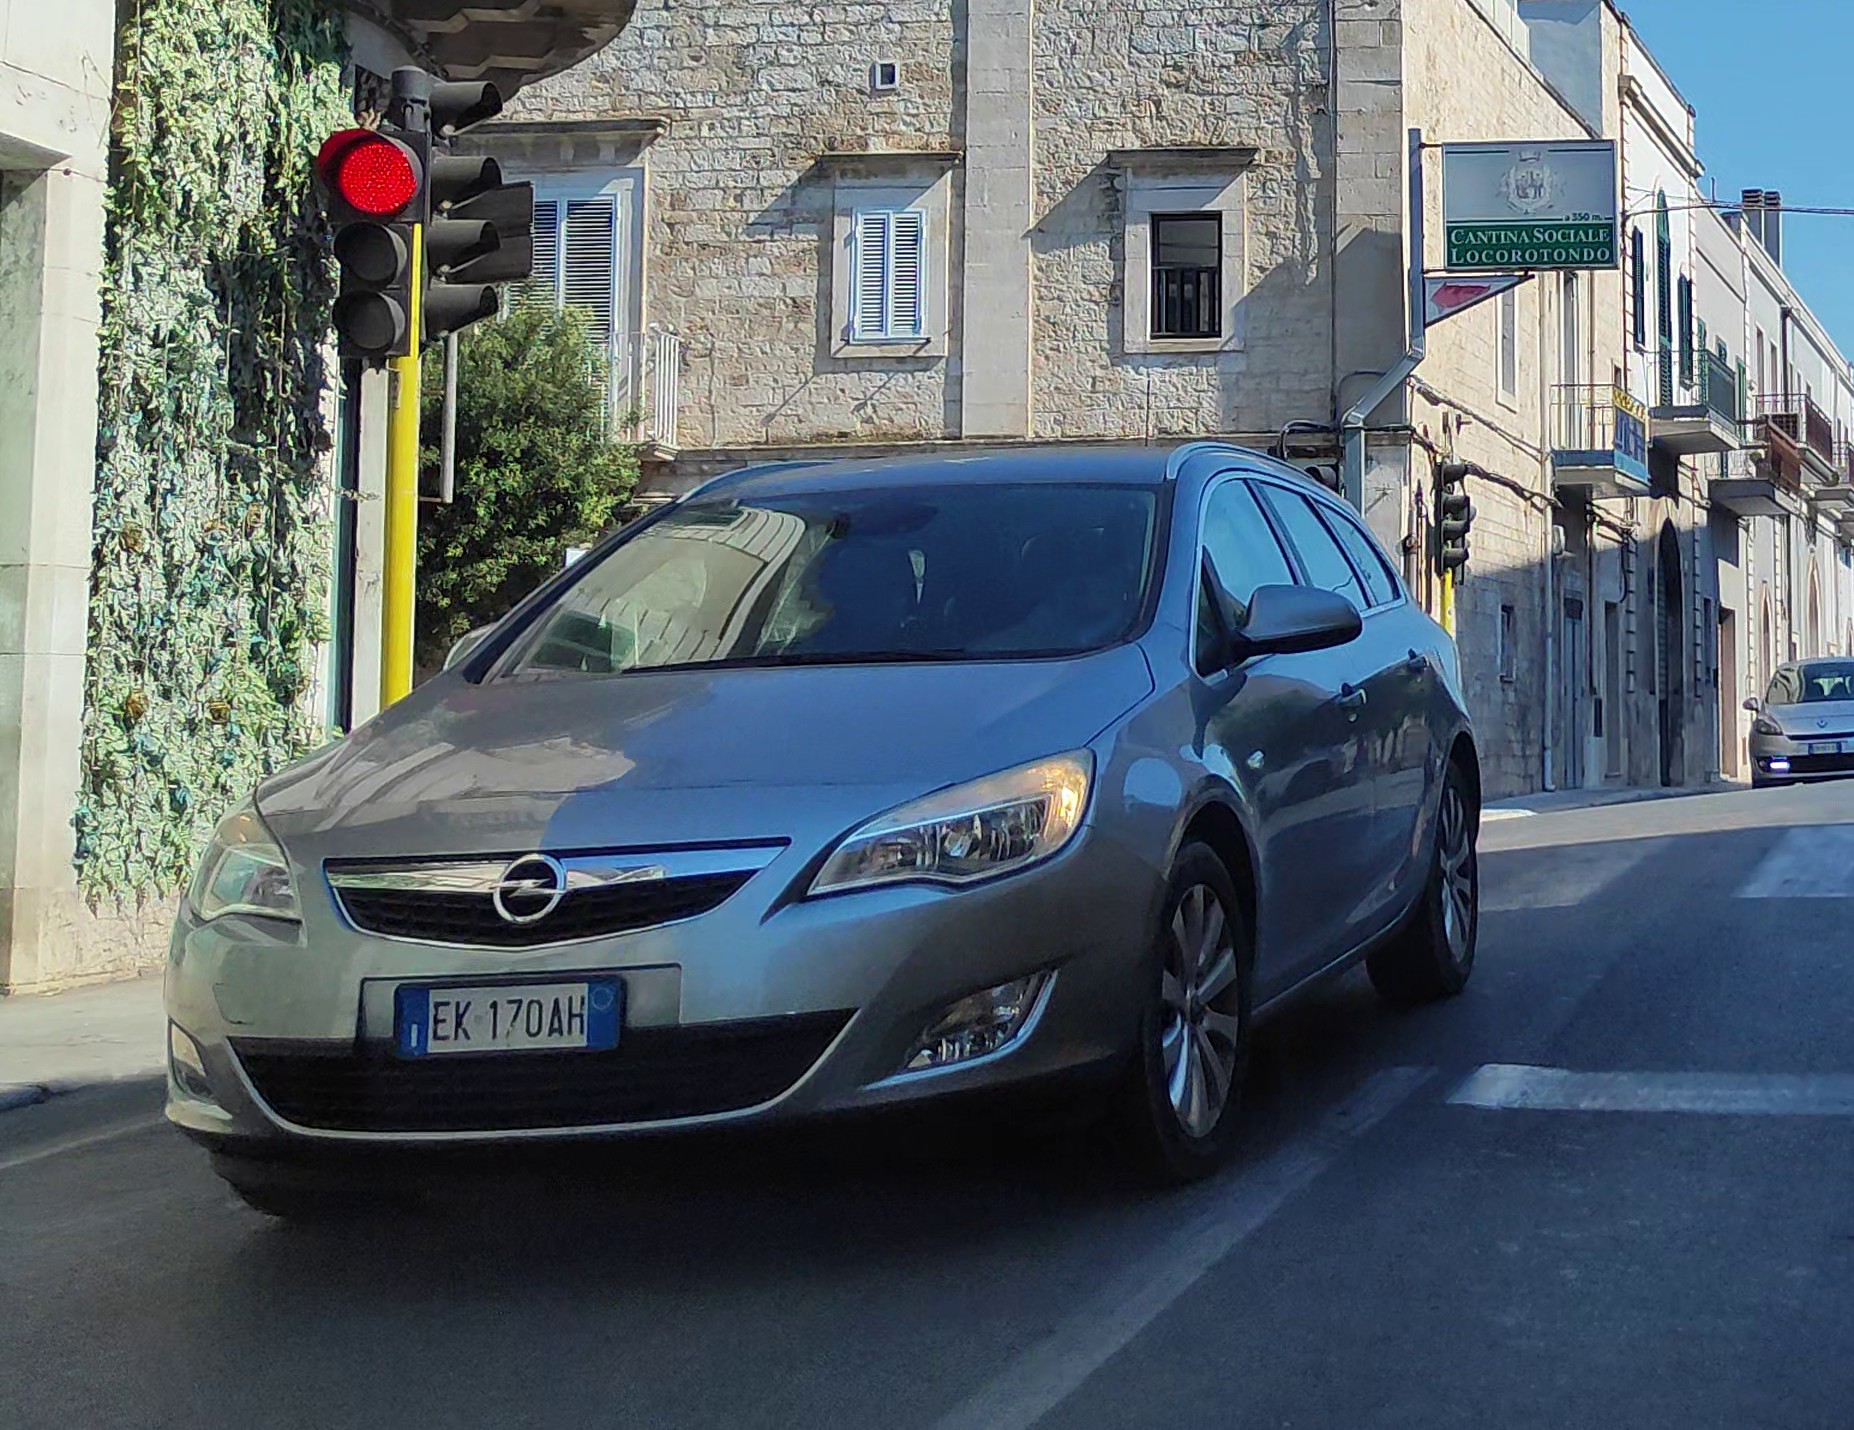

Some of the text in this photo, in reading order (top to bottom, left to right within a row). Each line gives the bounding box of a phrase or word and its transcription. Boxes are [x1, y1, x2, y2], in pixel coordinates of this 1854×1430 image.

[1571, 212, 1590, 221] 350
[1451, 228, 1610, 245] CANTINA SOCIALE
[1450, 247, 1610, 264] LOCOROTONDO
[432, 994, 585, 1041] EK 170AH
